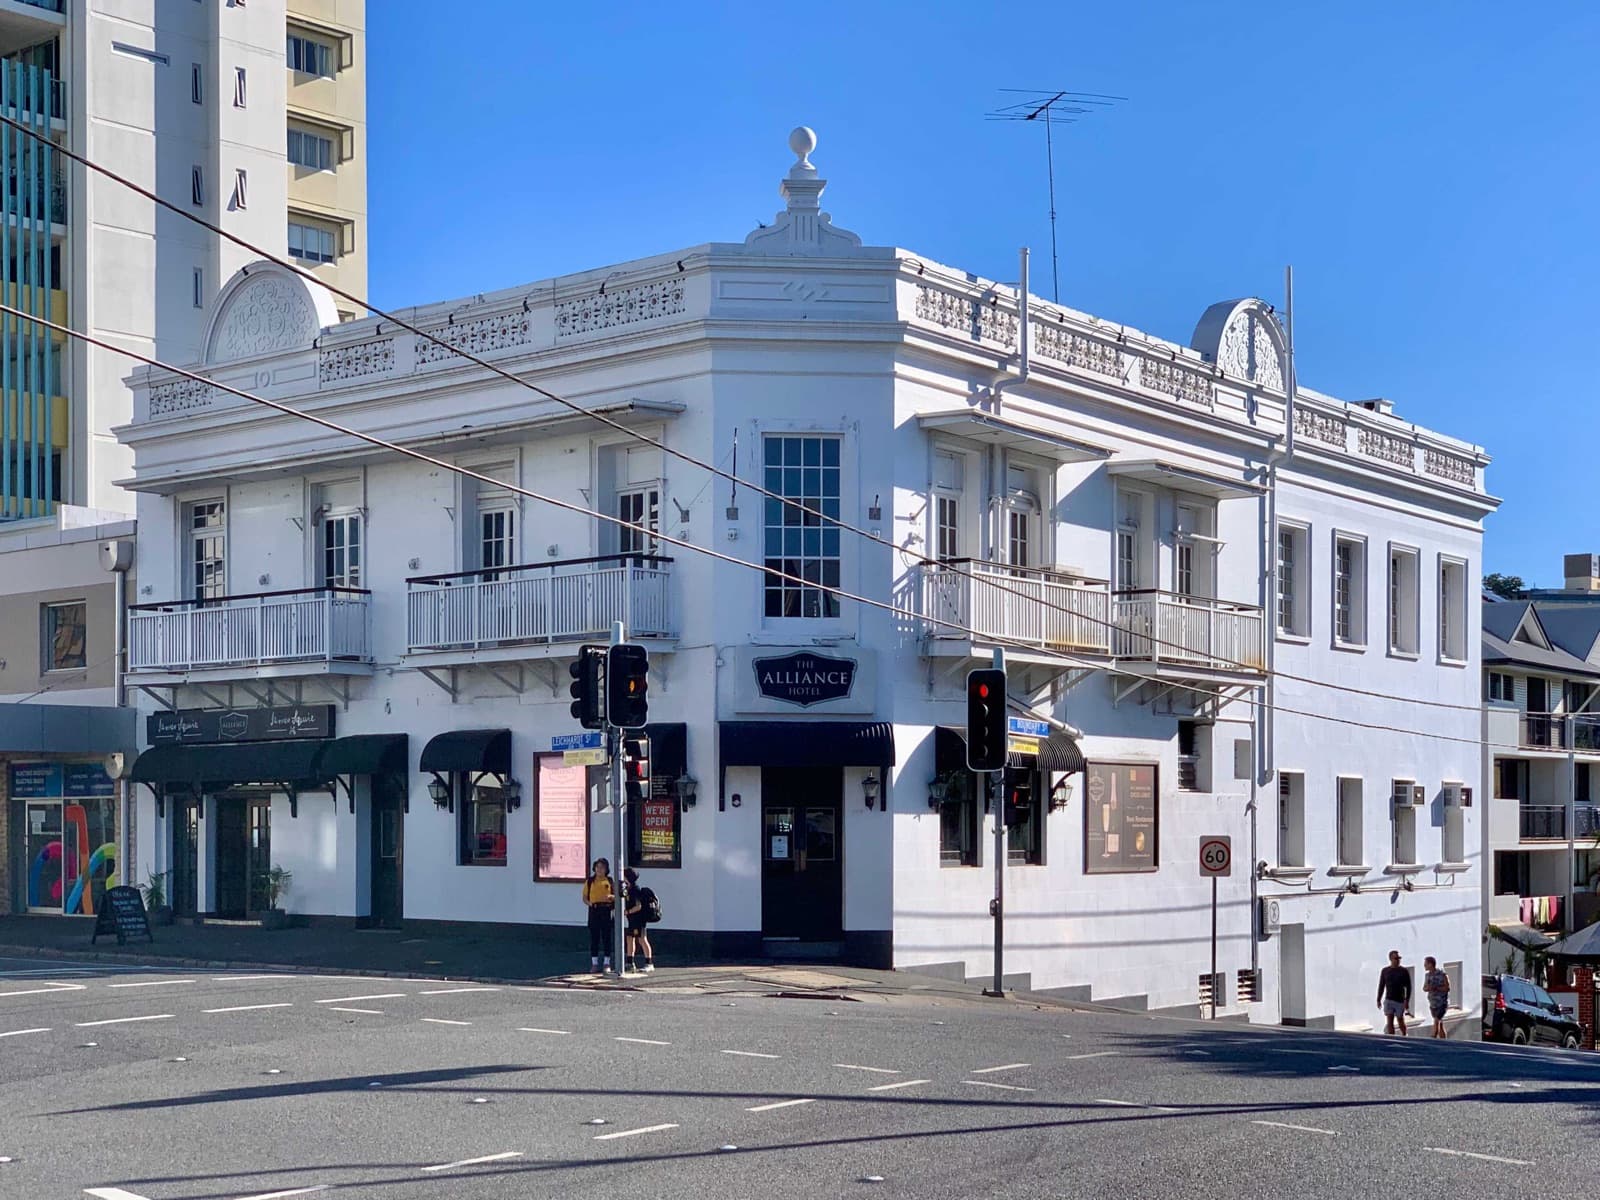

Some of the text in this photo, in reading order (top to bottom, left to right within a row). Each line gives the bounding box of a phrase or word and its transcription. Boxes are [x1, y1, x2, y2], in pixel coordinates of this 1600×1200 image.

[796, 660, 814, 669] THE
[763, 671, 849, 685] ALLIANCE
[788, 687, 821, 696] HOTEL
[645, 805, 671, 815] WE'RE
[645, 817, 669, 826] OPEN!
[1205, 849, 1225, 864] 60
